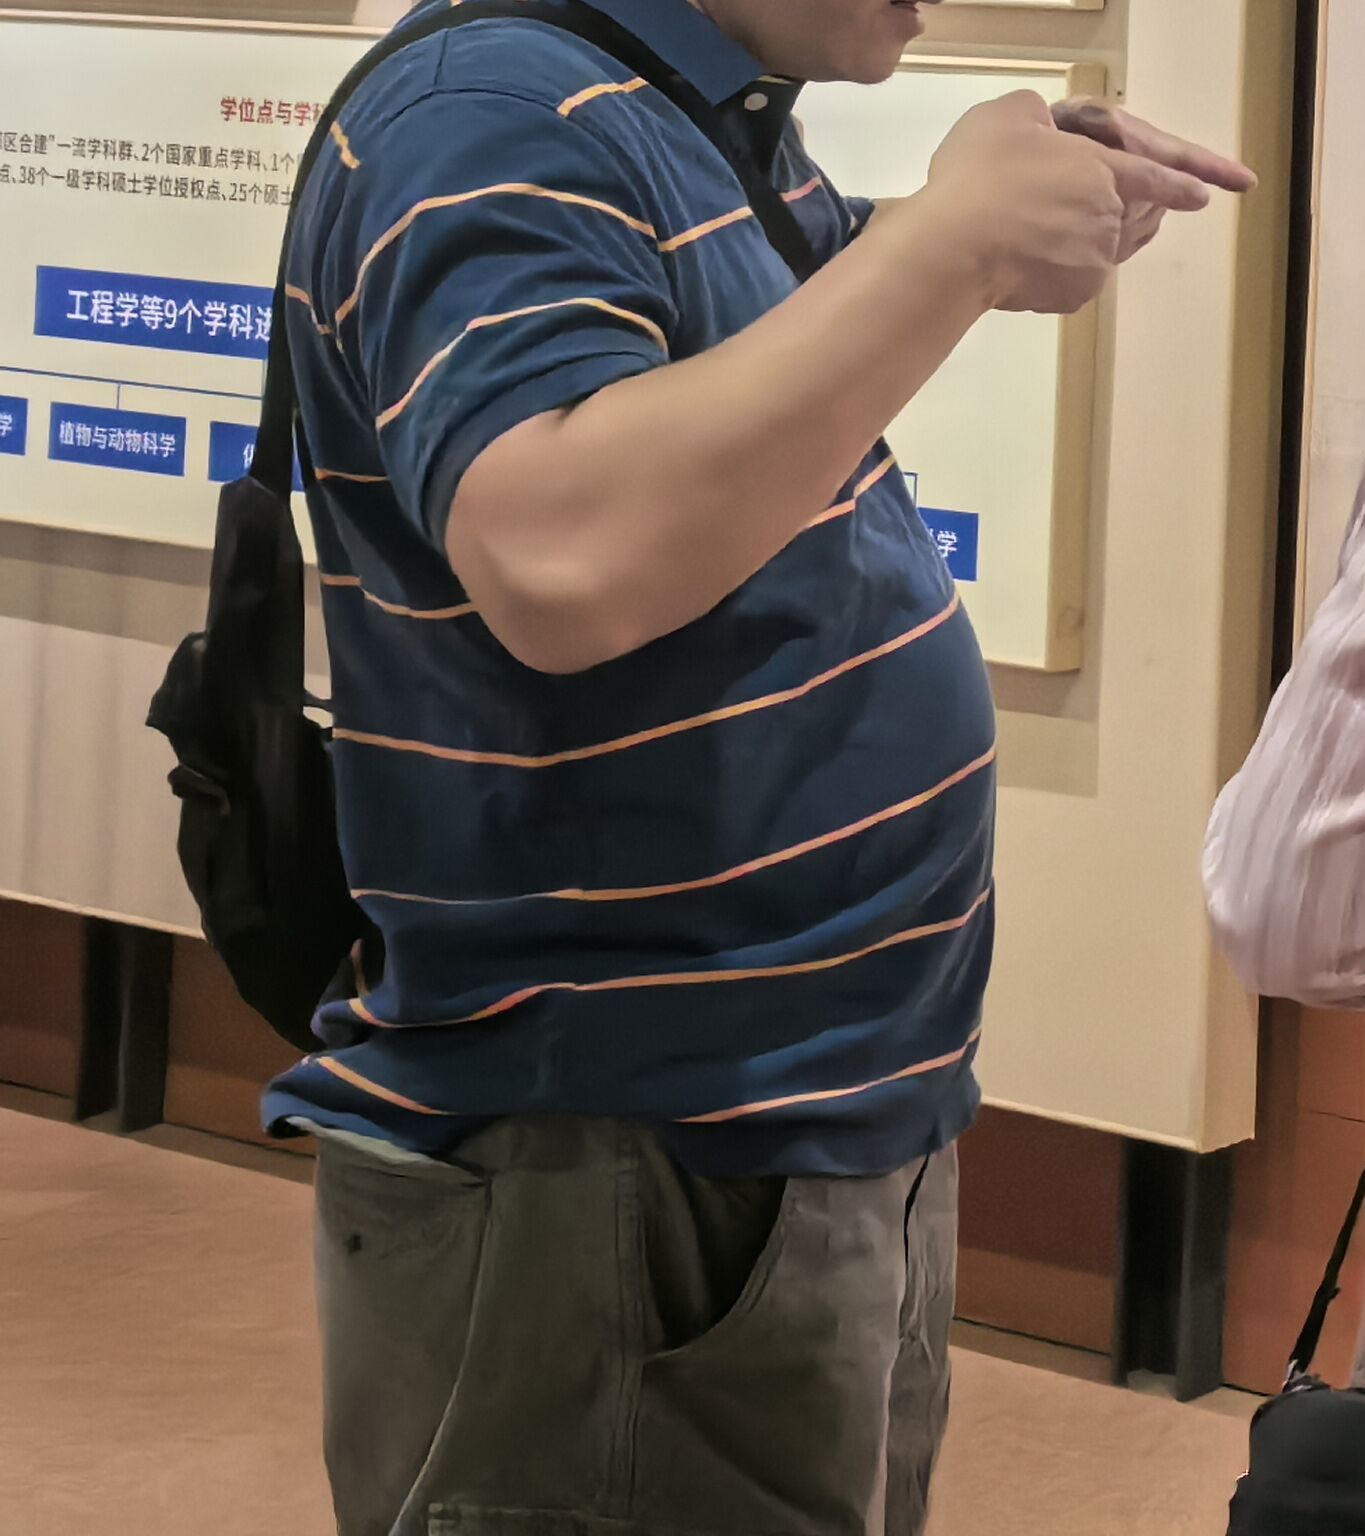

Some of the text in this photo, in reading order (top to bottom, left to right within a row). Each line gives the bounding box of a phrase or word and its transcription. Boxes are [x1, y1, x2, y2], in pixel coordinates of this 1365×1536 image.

[59, 420, 176, 458] 植物与动物科学
